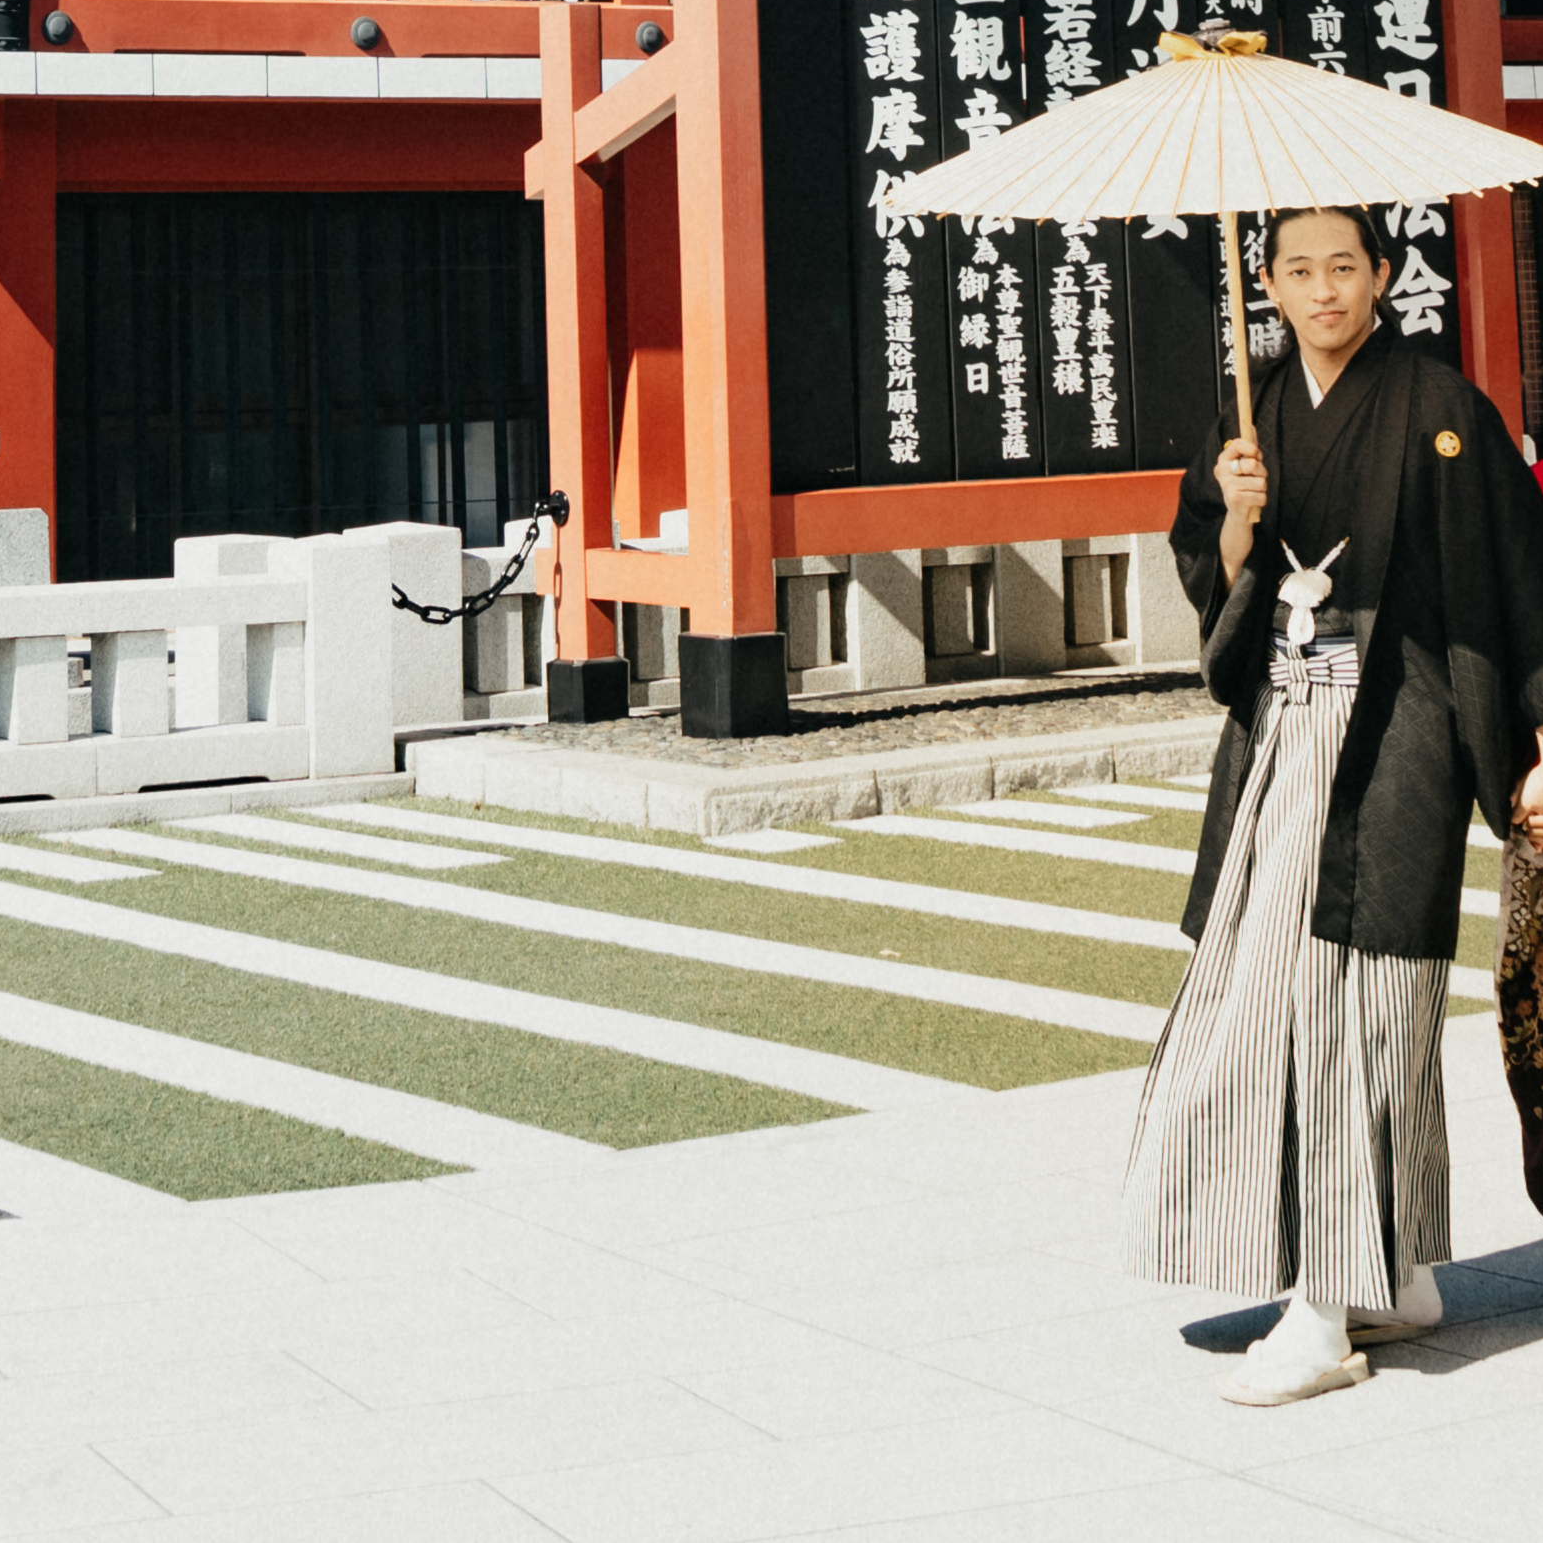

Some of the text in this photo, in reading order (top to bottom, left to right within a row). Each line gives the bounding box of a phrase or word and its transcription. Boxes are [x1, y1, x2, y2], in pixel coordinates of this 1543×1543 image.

[971, 235, 1000, 266] 為
[1063, 235, 1091, 265] 為
[1242, 211, 1287, 359] 後二時
[956, 265, 992, 395] 御縁日
[994, 261, 1031, 460] 本尊聖観世音菩薩
